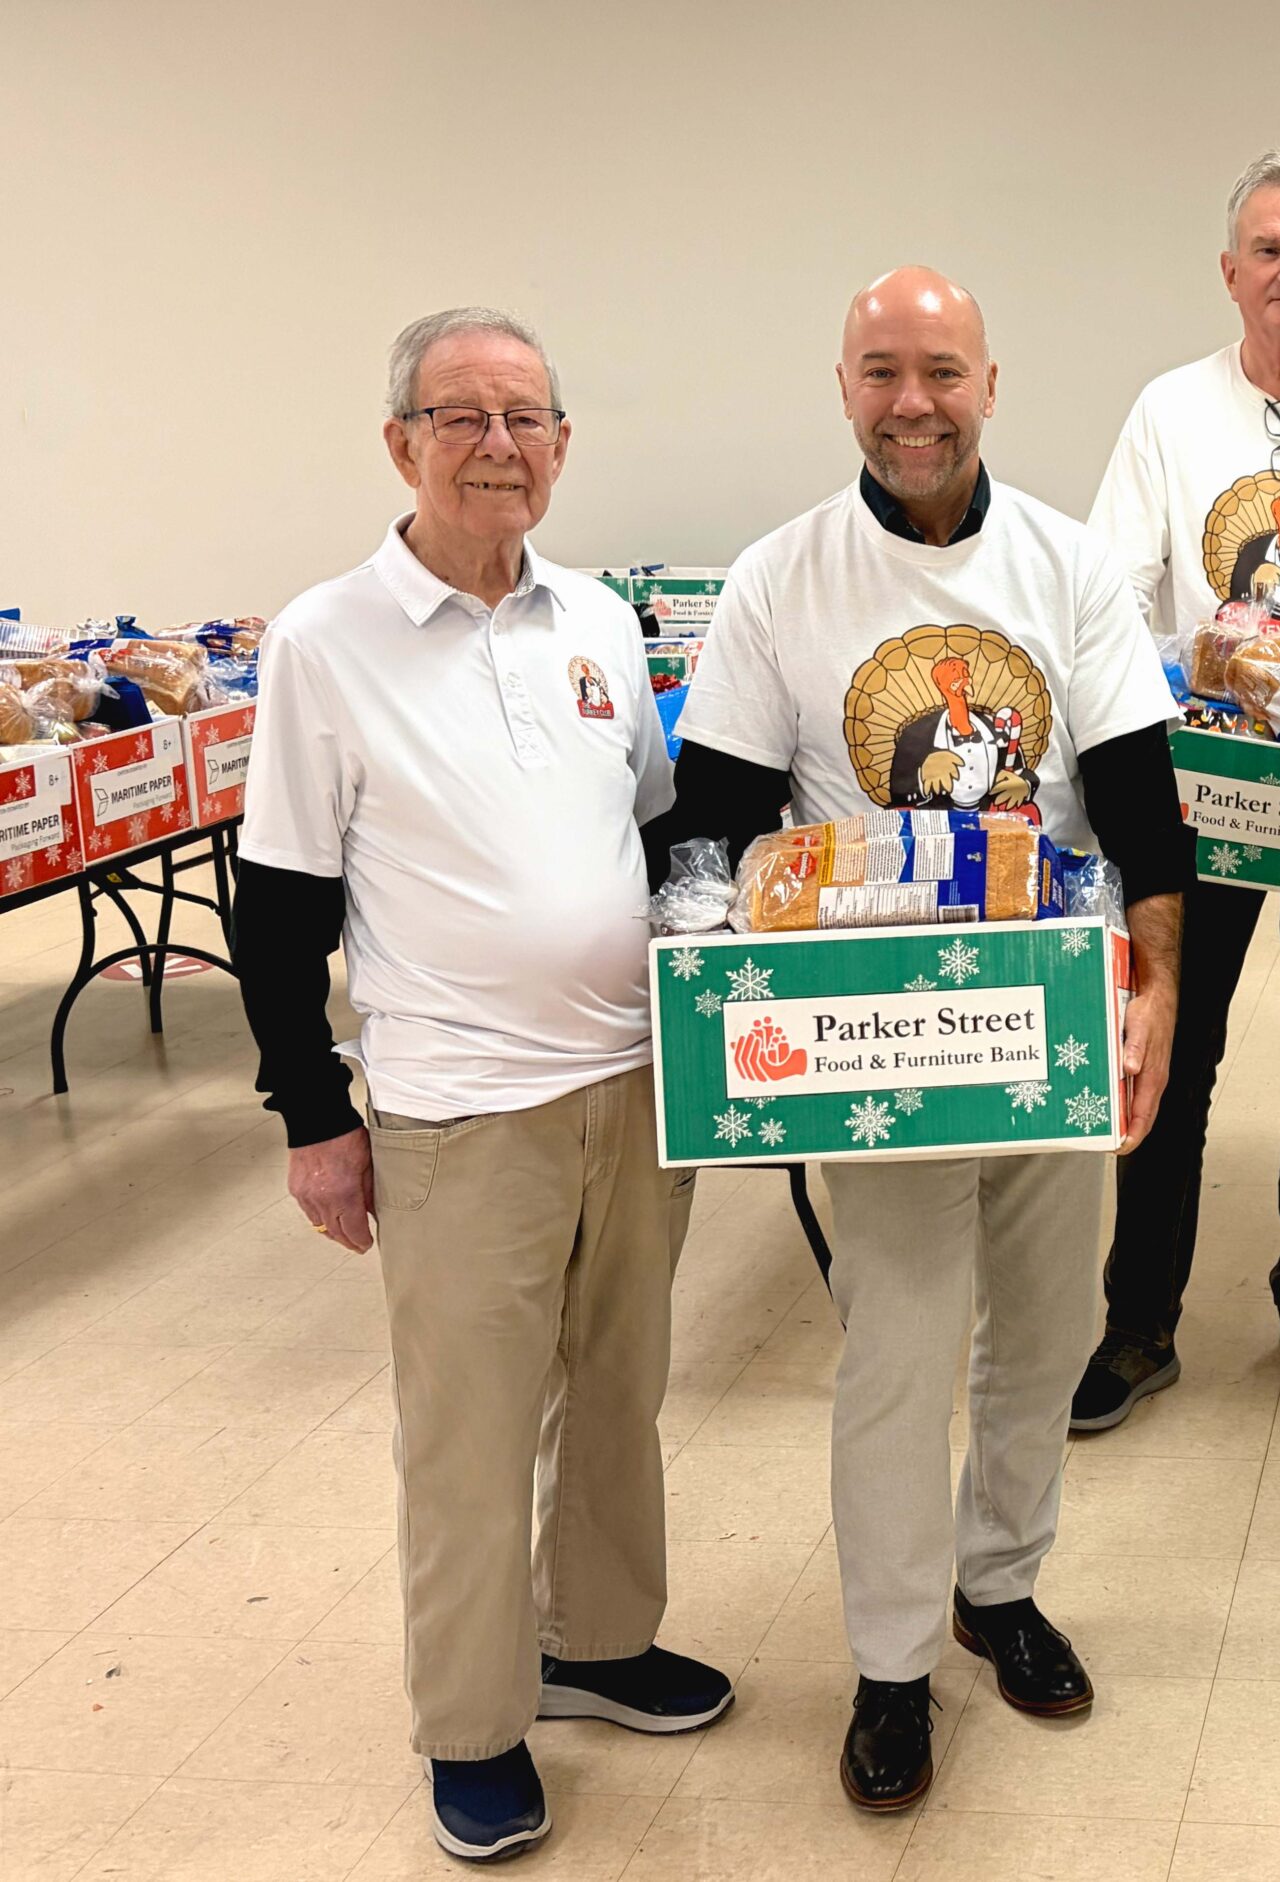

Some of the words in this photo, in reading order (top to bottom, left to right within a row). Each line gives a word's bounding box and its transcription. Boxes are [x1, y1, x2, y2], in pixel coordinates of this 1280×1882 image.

[673, 599, 702, 607] Parker
[111, 782, 148, 804] MARITIME
[149, 775, 172, 792] PAPER
[1196, 783, 1271, 815] Parker
[0, 822, 30, 841] RITIME
[31, 814, 60, 833] PAPER
[1192, 811, 1225, 827] Food
[1229, 818, 1241, 829] &
[813, 1011, 926, 1042] Parker
[937, 1007, 1036, 1036] Street
[814, 1055, 863, 1073] Food
[869, 1054, 887, 1070] &
[893, 1050, 984, 1069] Furniture
[990, 1045, 1040, 1063] Bank
